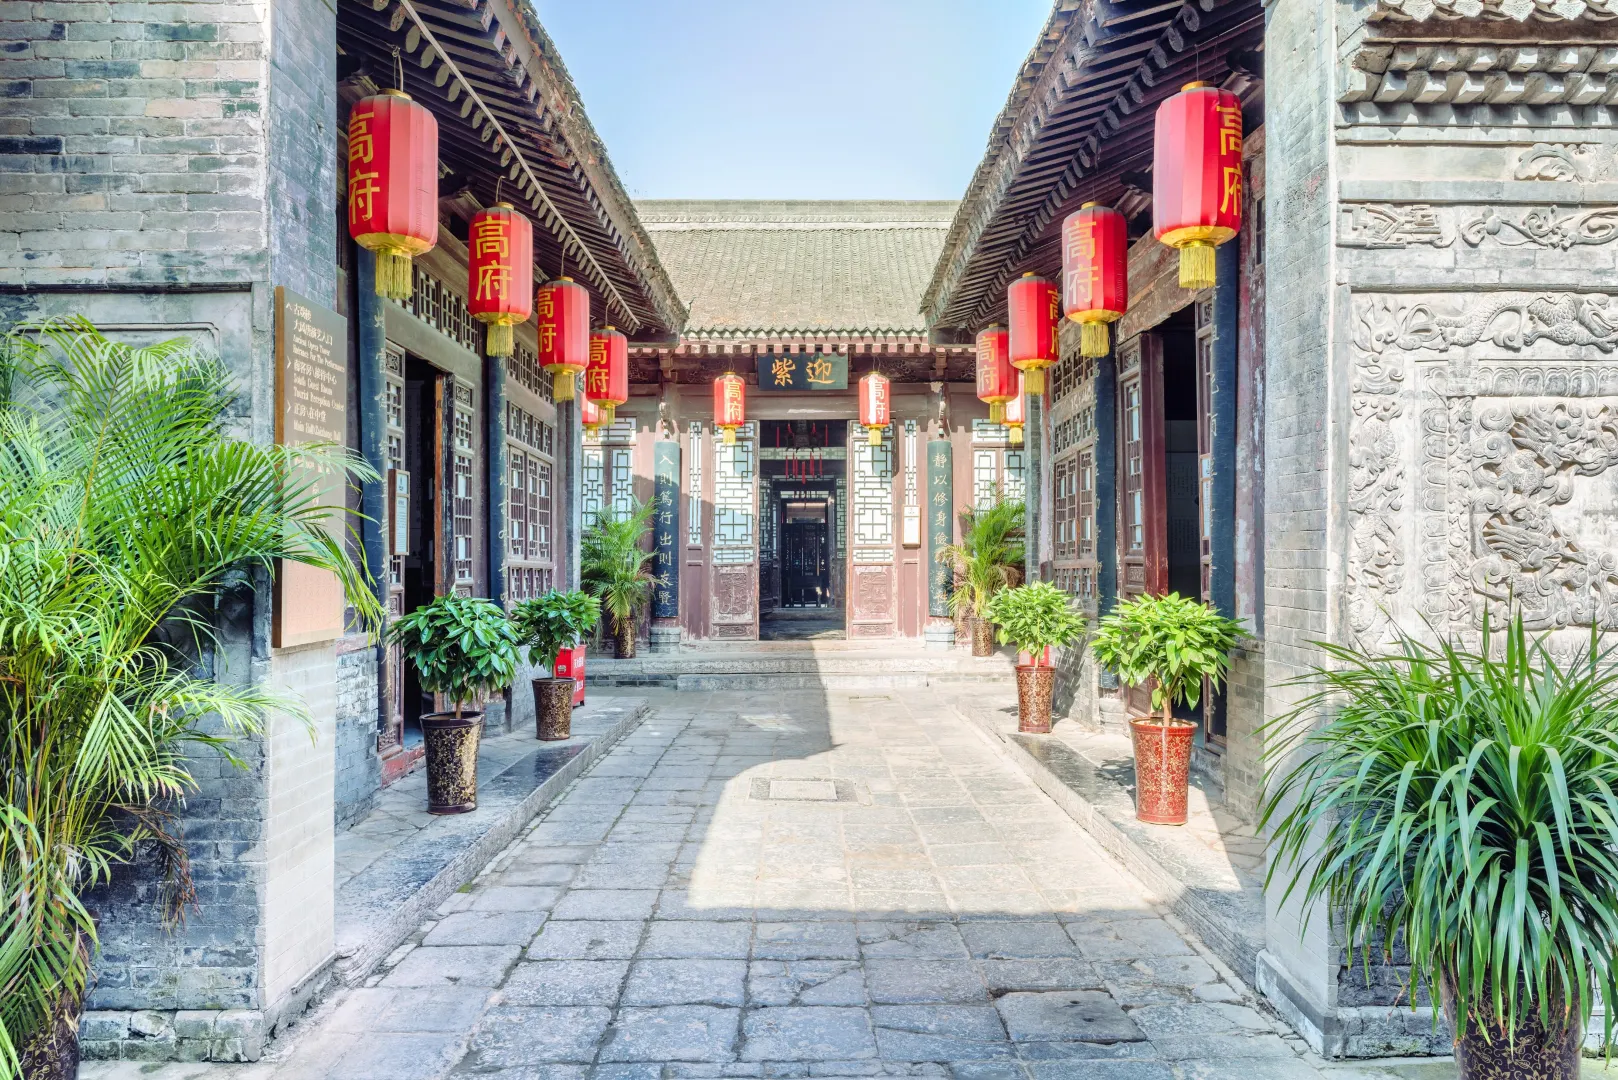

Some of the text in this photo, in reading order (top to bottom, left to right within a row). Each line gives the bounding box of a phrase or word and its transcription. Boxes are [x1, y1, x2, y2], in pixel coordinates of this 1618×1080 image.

[349, 111, 380, 225] 高府
[1216, 102, 1242, 218] 高府
[474, 215, 512, 301] 高府
[1065, 220, 1099, 305] 高府
[308, 340, 319, 352] Opera
[538, 287, 556, 353] 高府
[587, 336, 609, 393] 高府
[976, 335, 996, 391] 高府
[293, 386, 309, 400] Tourist
[310, 391, 331, 408] Reception
[725, 379, 742, 421] 高府
[868, 379, 886, 423] 高府
